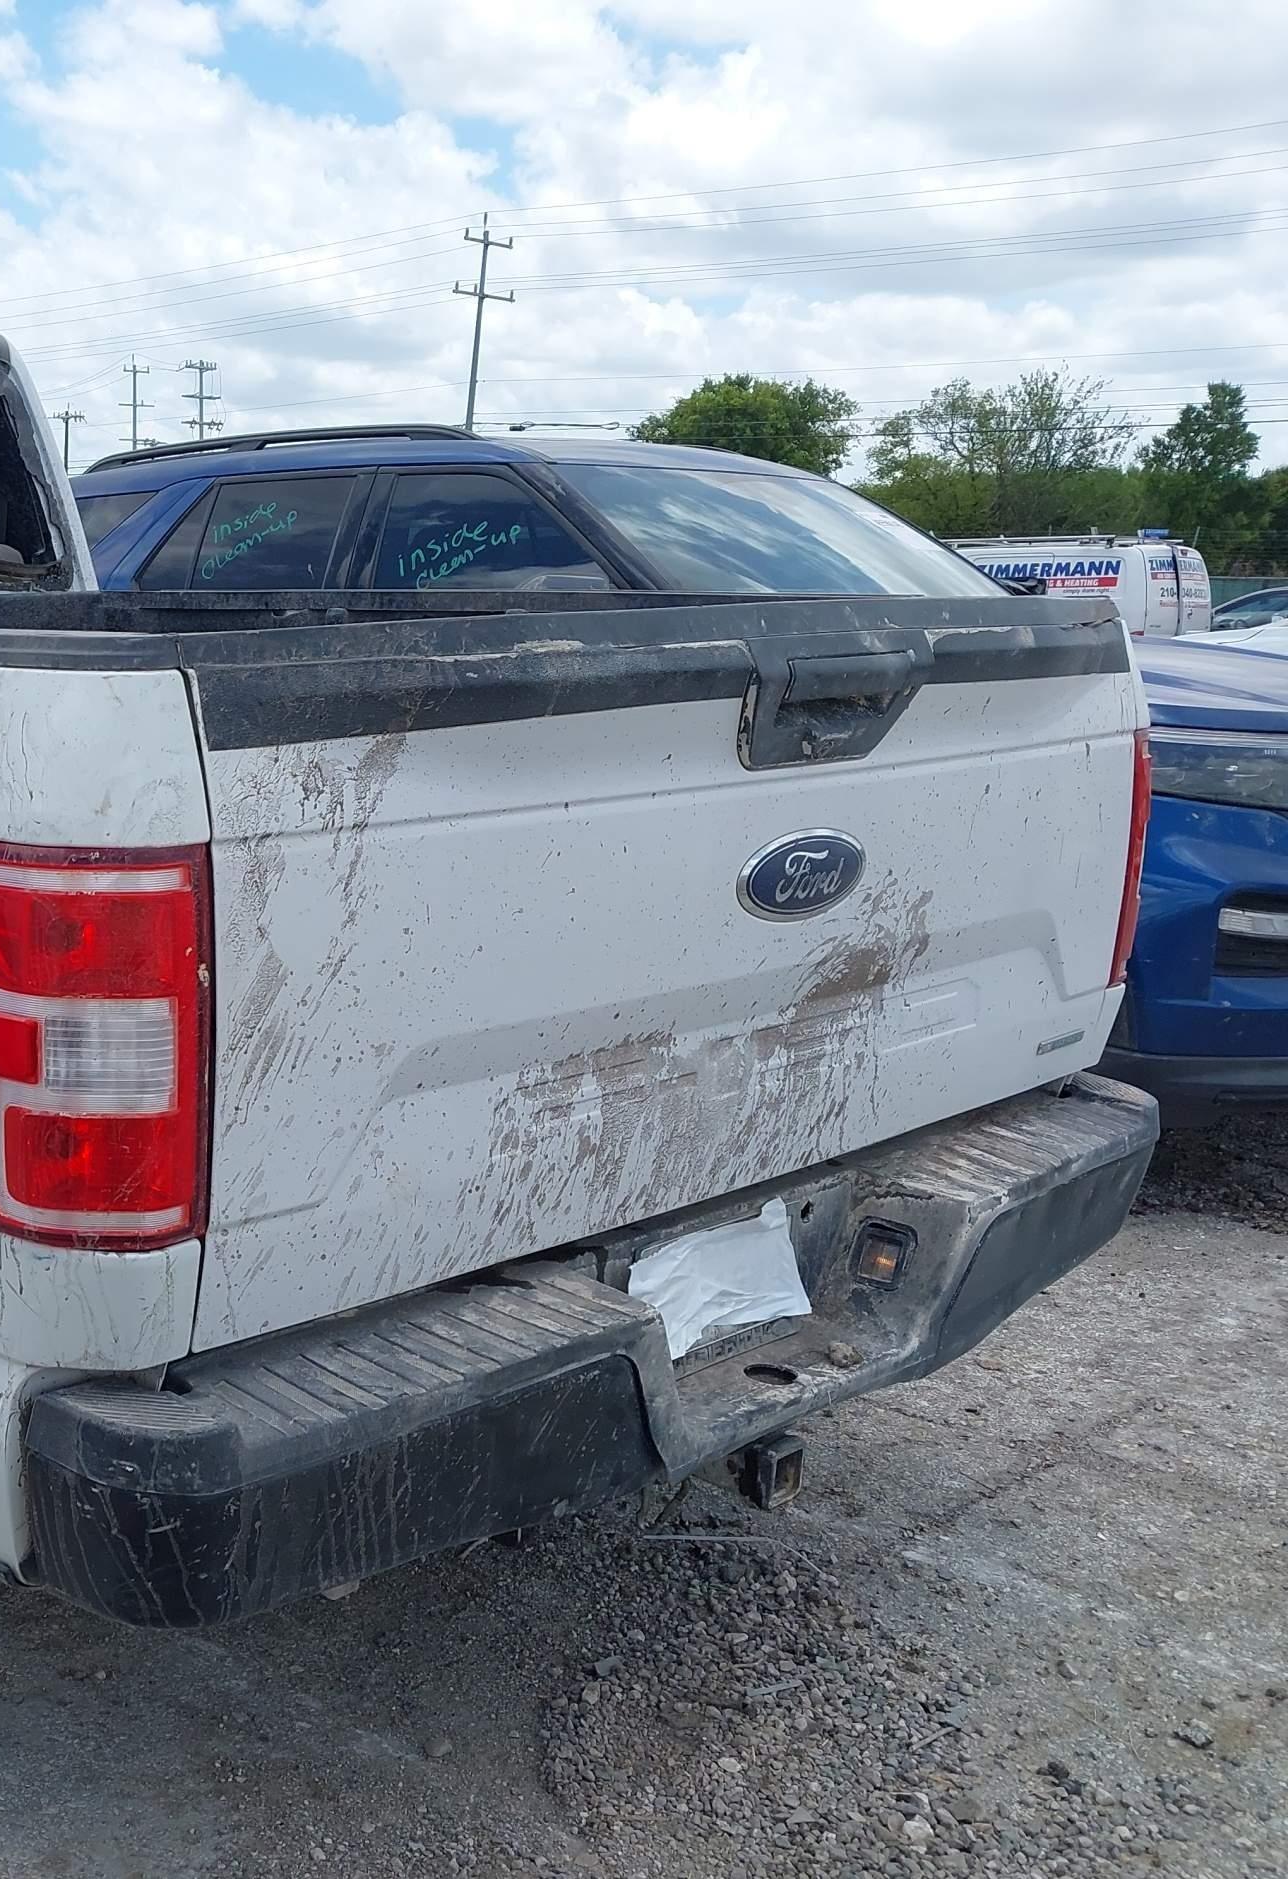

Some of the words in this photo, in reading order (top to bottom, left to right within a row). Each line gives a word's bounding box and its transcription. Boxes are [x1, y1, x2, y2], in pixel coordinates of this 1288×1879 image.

[211, 502, 277, 544] inside
[397, 520, 489, 577] inside
[1064, 577, 1100, 587] HEATING
[775, 848, 846, 904] Ford
